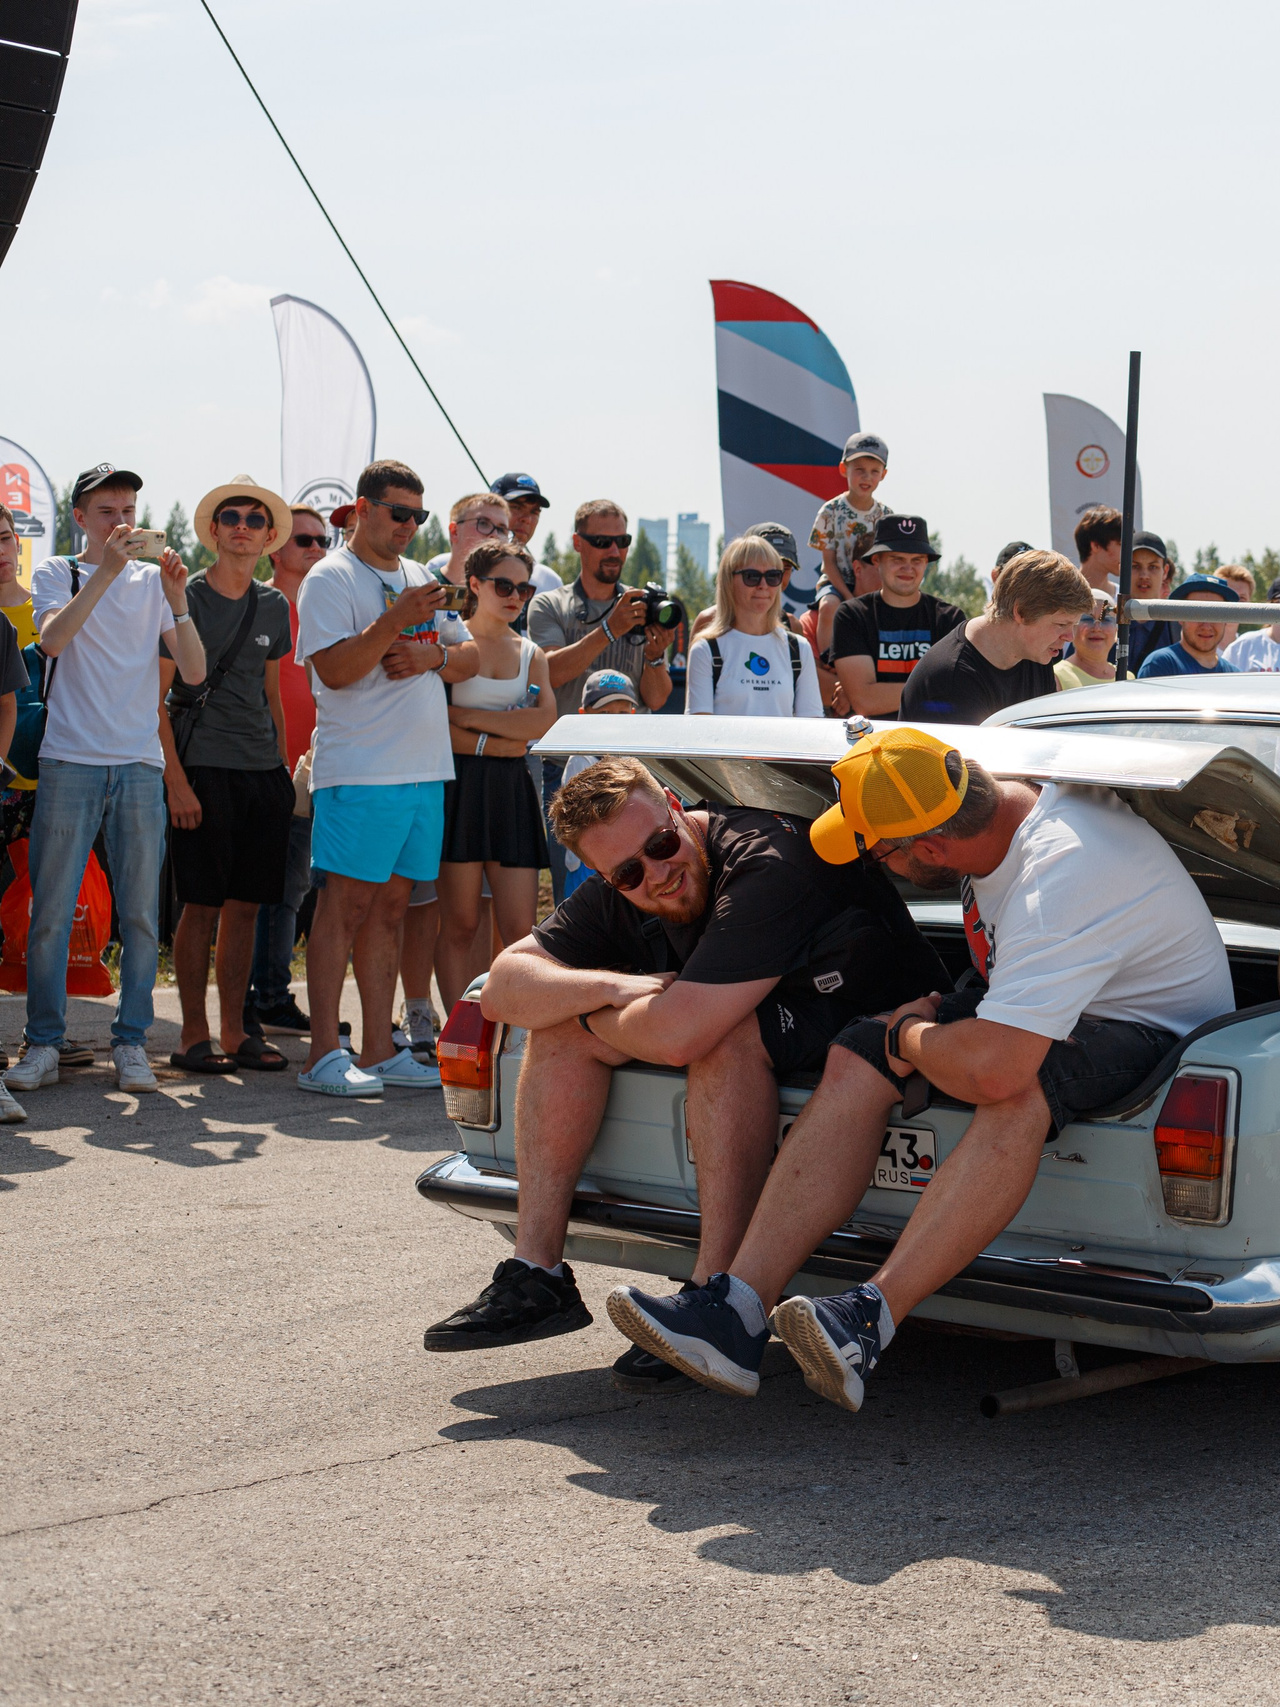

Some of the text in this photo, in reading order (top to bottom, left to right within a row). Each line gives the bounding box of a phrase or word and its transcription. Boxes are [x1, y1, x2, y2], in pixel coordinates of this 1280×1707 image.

[817, 974, 839, 987] PUMA
[320, 1083, 347, 1094] crocs
[881, 1131, 919, 1170] 43
[878, 1168, 909, 1185] RUS
